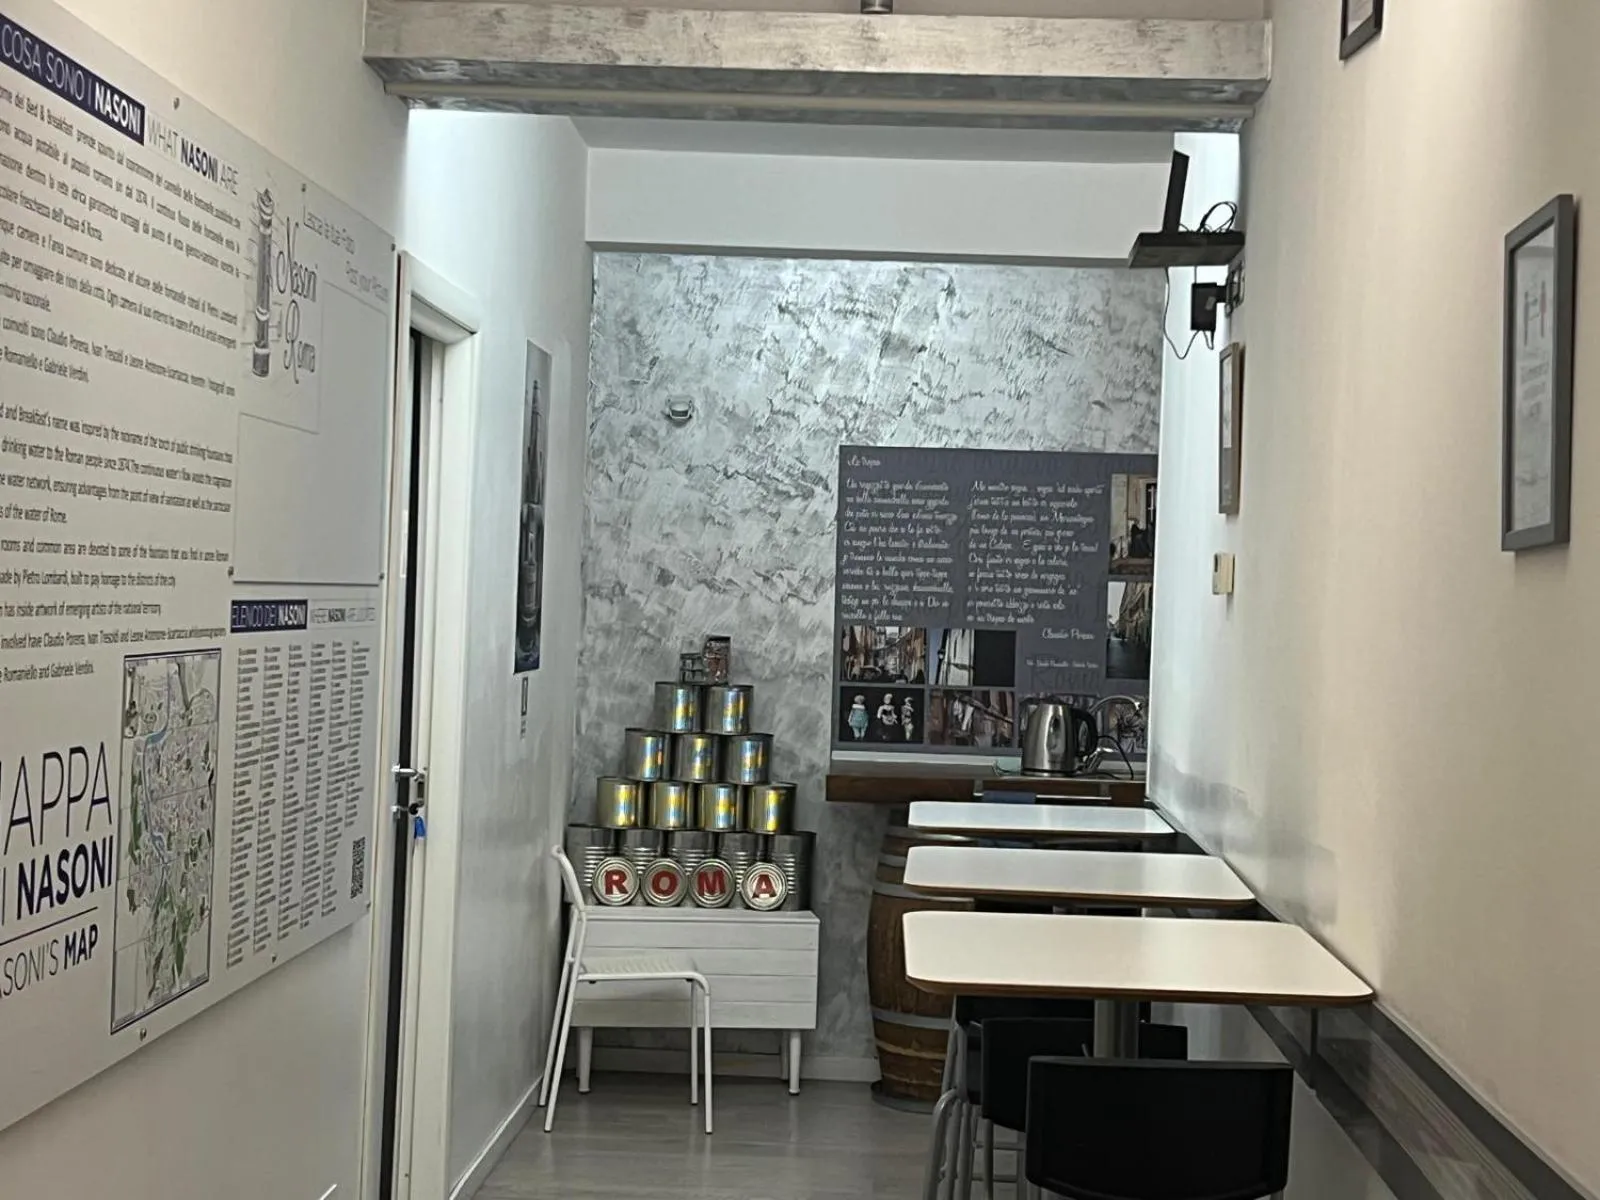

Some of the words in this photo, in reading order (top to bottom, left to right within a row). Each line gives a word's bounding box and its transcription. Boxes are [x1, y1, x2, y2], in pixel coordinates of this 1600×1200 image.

[1, 24, 42, 76] COSA
[46, 51, 85, 101] SONO
[87, 77, 92, 107] I
[95, 82, 142, 136] NASONI
[148, 117, 179, 156] WHAT
[180, 137, 219, 183] NASONI
[284, 300, 315, 384] Roma
[23, 569, 39, 584] Pietro
[43, 632, 64, 646] Claudio
[278, 604, 306, 627] NASONI
[4, 664, 37, 681] Romaniello
[0, 741, 112, 855] APPA
[17, 835, 113, 920] NASONI
[604, 868, 777, 899] ROMA
[0, 938, 59, 1000] SONI'S
[64, 923, 98, 971] MAP
